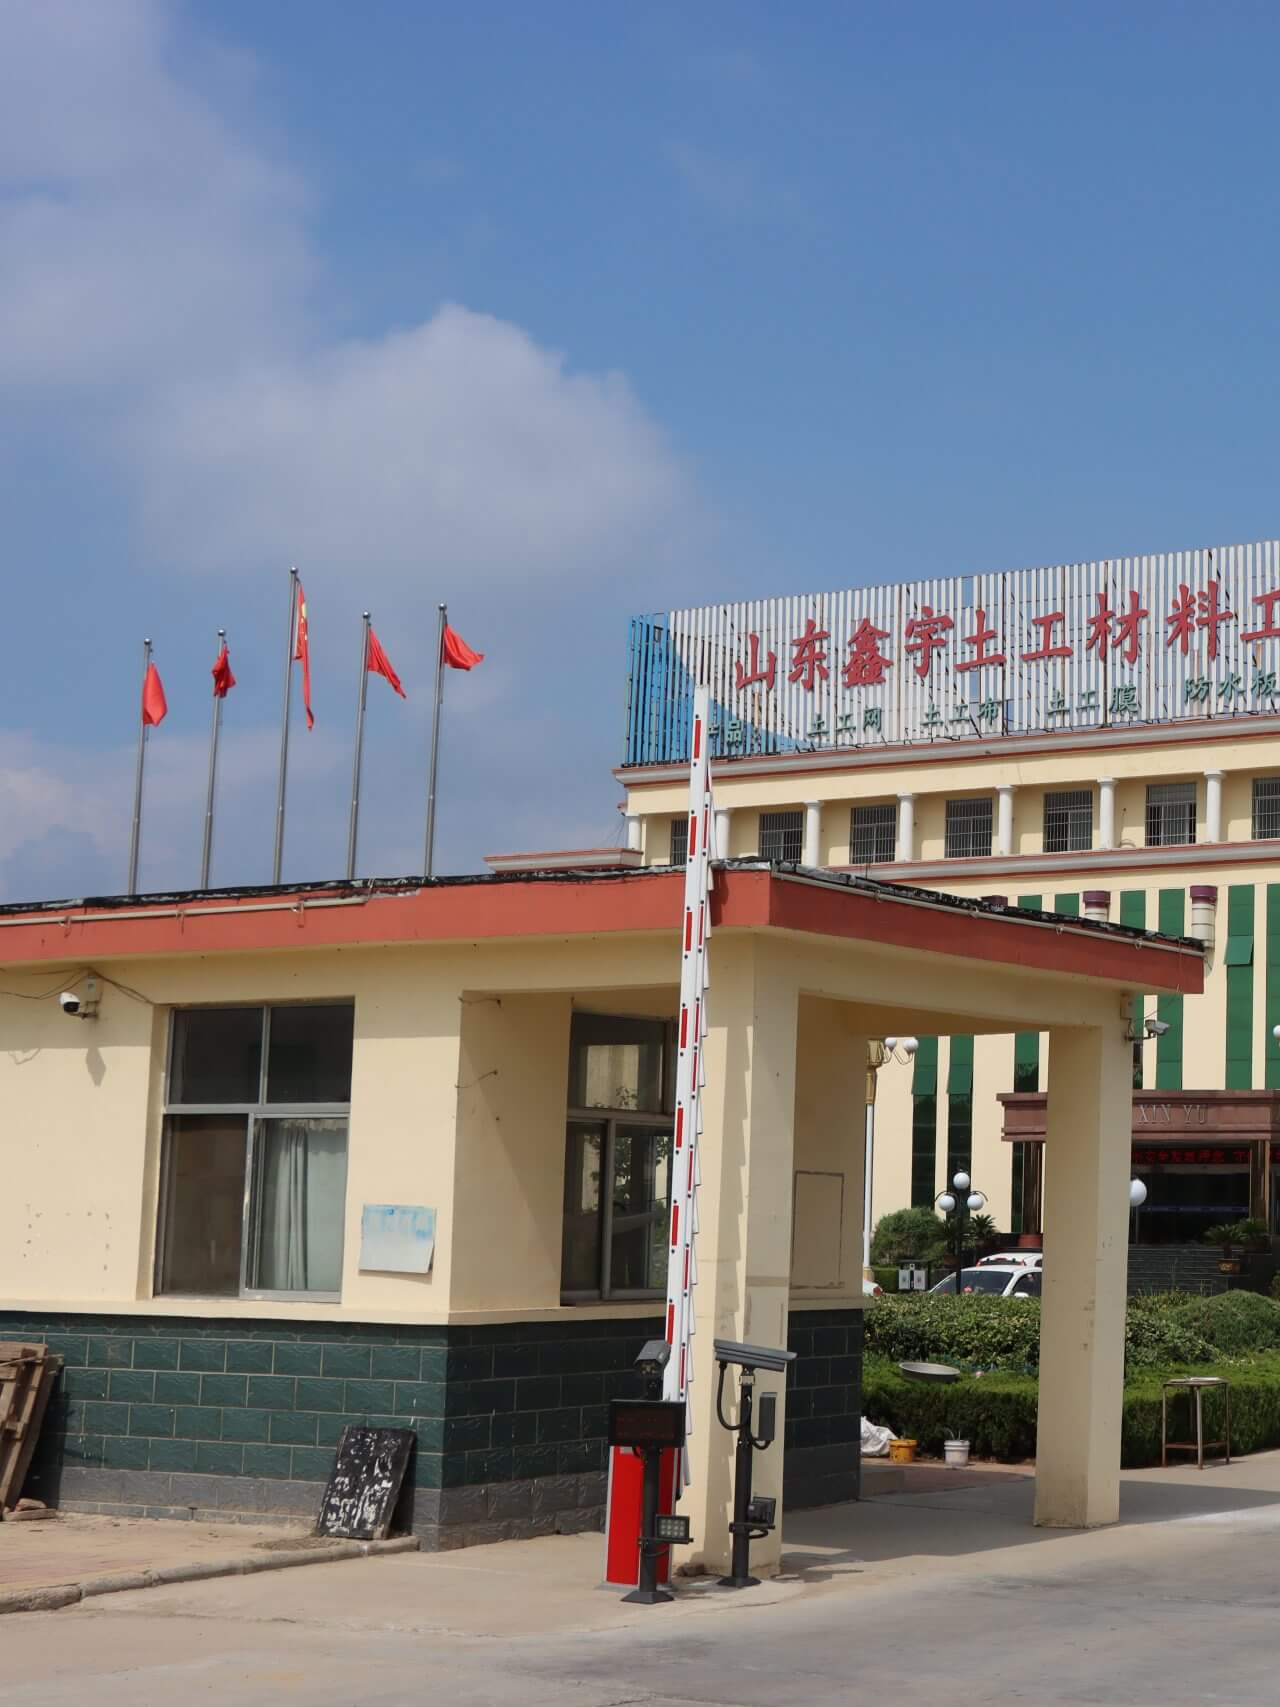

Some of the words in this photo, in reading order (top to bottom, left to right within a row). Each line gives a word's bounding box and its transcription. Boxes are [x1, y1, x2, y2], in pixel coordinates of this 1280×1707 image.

[808, 706, 882, 738] 土工网
[922, 696, 1000, 727] 土工布
[1048, 685, 1139, 718] 土工膜
[1138, 1103, 1171, 1124] XIN
[1183, 1103, 1208, 1124] YU
